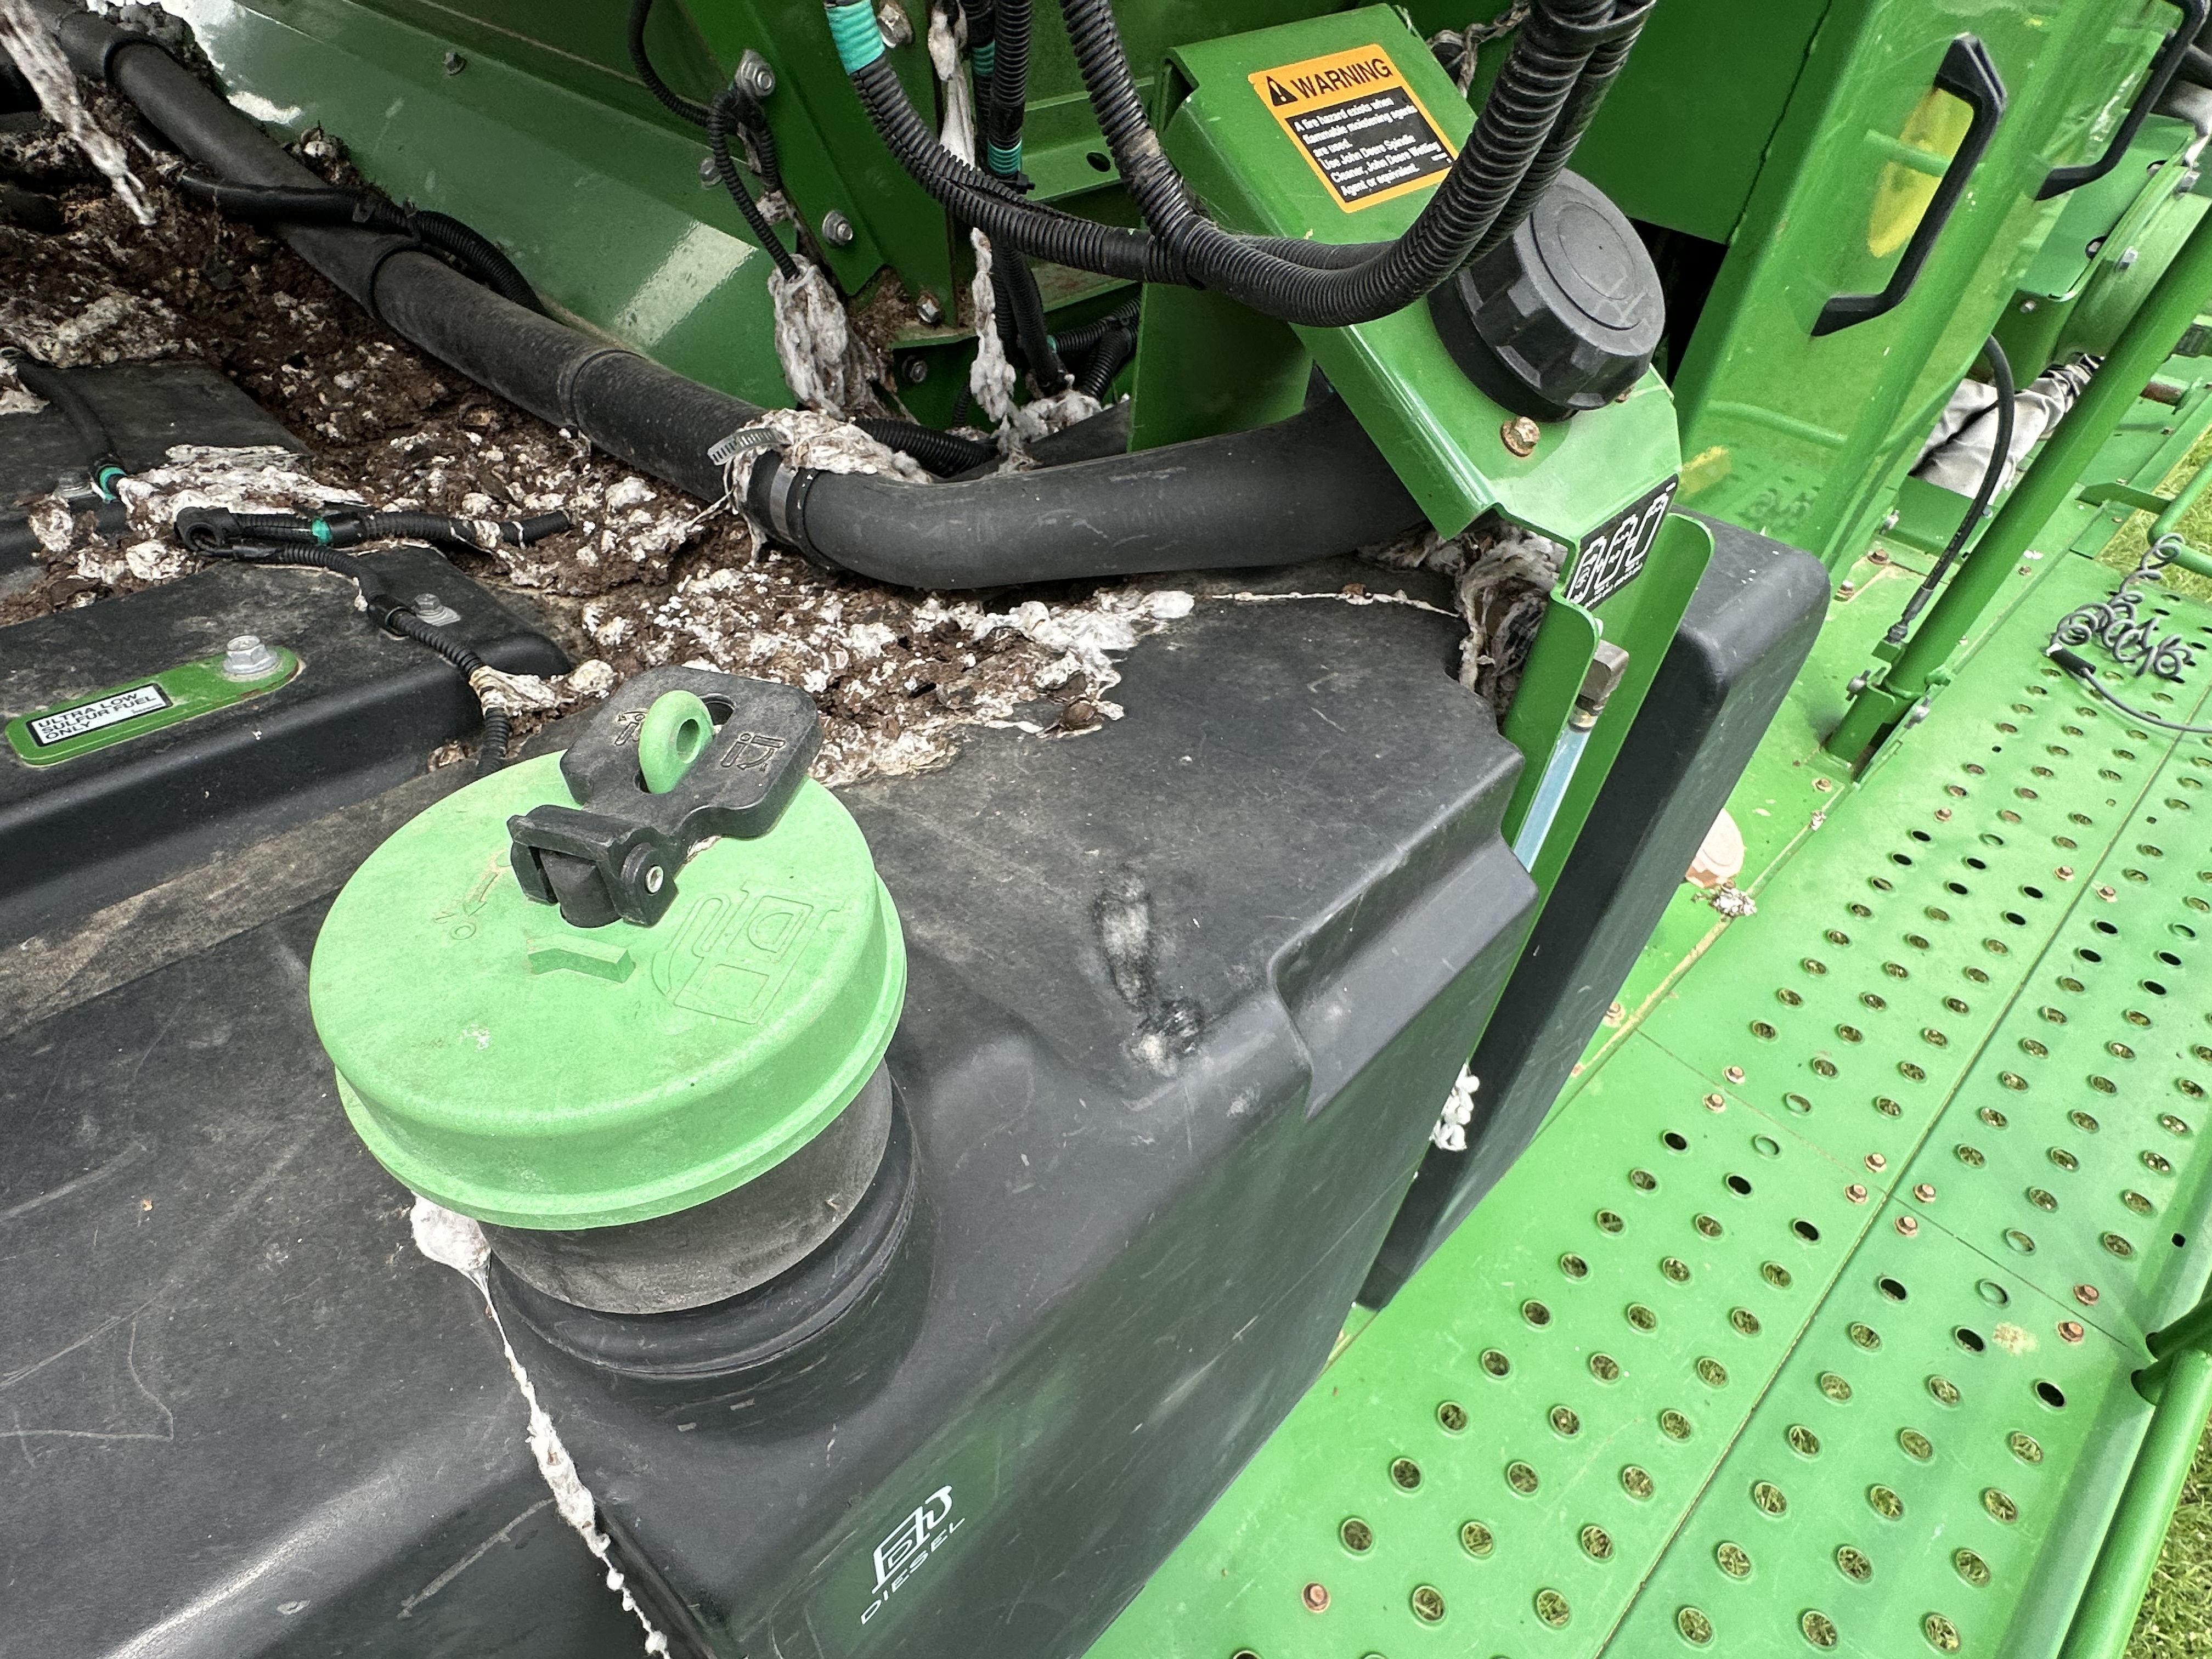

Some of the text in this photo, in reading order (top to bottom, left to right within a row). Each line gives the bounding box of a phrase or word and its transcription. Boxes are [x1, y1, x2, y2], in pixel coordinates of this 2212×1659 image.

[1290, 58, 1393, 99] WARNING
[1294, 97, 1395, 132] A fire hazard exists when
[1302, 105, 1418, 145] flammable moistening agents
[1312, 146, 1329, 158] are
[1318, 134, 1416, 170] Use John Deere Spindle
[1366, 158, 1389, 172] John
[1384, 151, 1412, 165] Deere
[1407, 142, 1442, 157] Wetting
[1340, 179, 1368, 196] Agent
[1366, 178, 1378, 188] or
[38, 707, 97, 727] ULTRA
[100, 693, 137, 709] LOW
[42, 709, 110, 733] SULFUR
[113, 696, 157, 711] FUEL
[46, 721, 90, 739] ONLY
[860, 1517, 966, 1624] DIESEL
